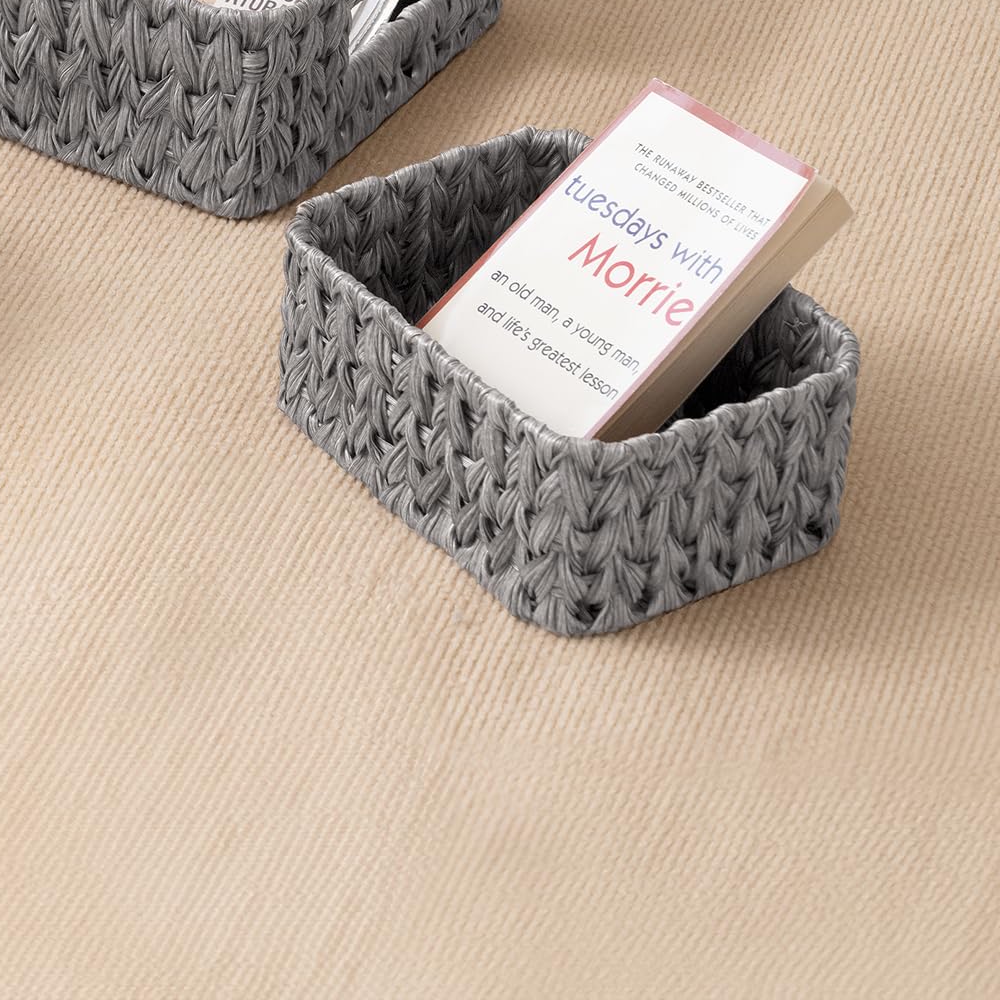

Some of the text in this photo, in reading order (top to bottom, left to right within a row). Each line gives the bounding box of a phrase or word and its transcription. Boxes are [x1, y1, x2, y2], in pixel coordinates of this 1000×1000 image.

[564, 174, 724, 284] tuesdays with
[634, 162, 759, 240] CHANGED MILLIONS OF LIVES
[635, 142, 771, 227] THE RUNAWAY BESTSELLER THAT
[490, 270, 640, 376] an old man, a young man,
[567, 232, 694, 326] Morrie
[477, 302, 619, 401] and life's greatest lesson
